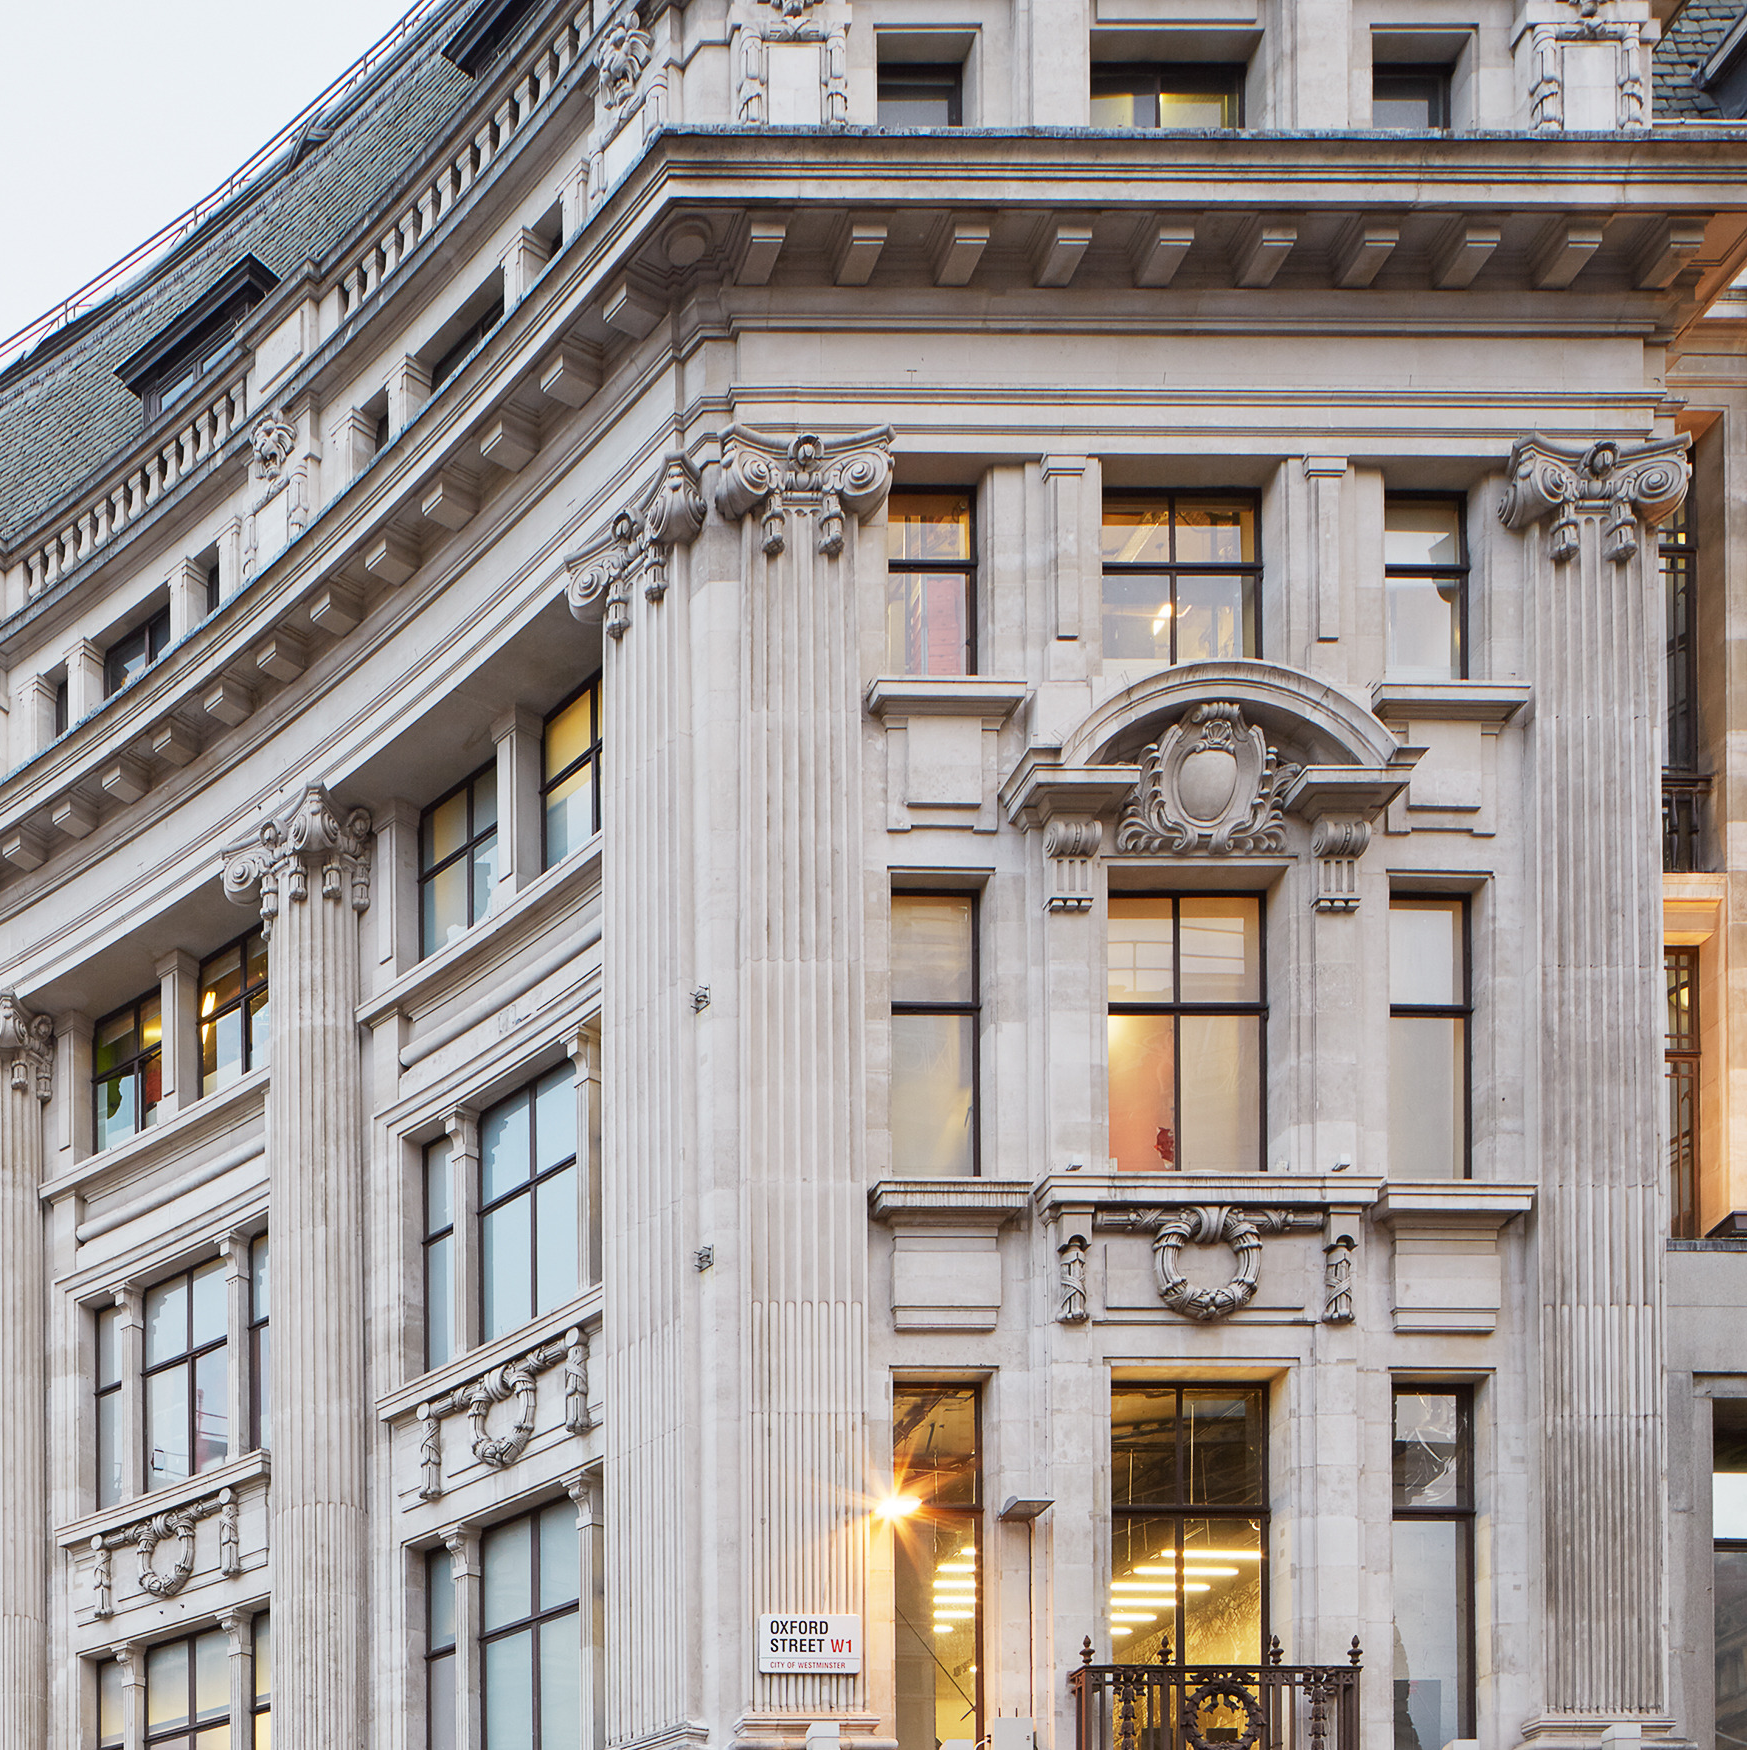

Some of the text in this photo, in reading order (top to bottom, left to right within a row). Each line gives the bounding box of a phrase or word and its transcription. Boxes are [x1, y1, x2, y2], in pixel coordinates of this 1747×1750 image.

[770, 1620, 829, 1634] OXFORD
[770, 1638, 852, 1653] STREET W1
[797, 1661, 846, 1669] WESTMINSTER
